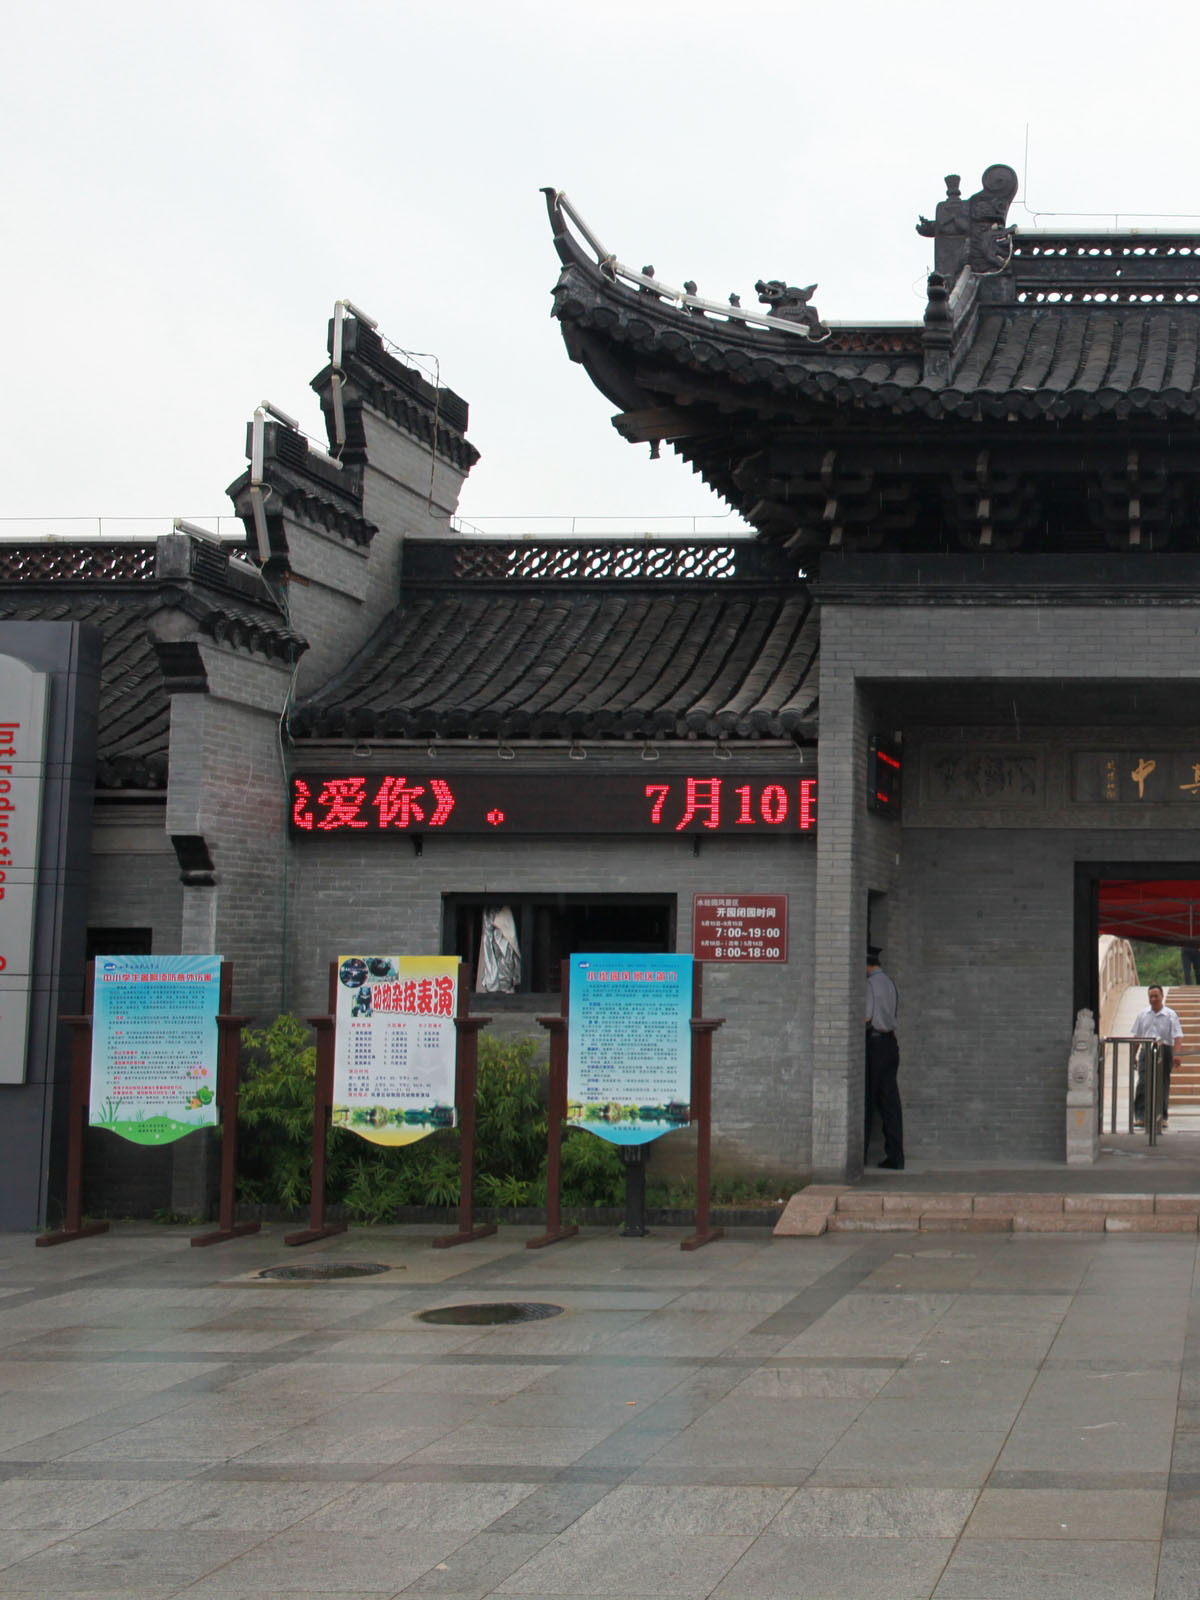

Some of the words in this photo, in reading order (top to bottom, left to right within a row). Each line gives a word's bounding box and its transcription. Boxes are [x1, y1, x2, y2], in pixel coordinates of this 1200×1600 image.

[716, 907, 777, 918] 开园闭园时间
[373, 975, 454, 1018] 动物杂技表演
